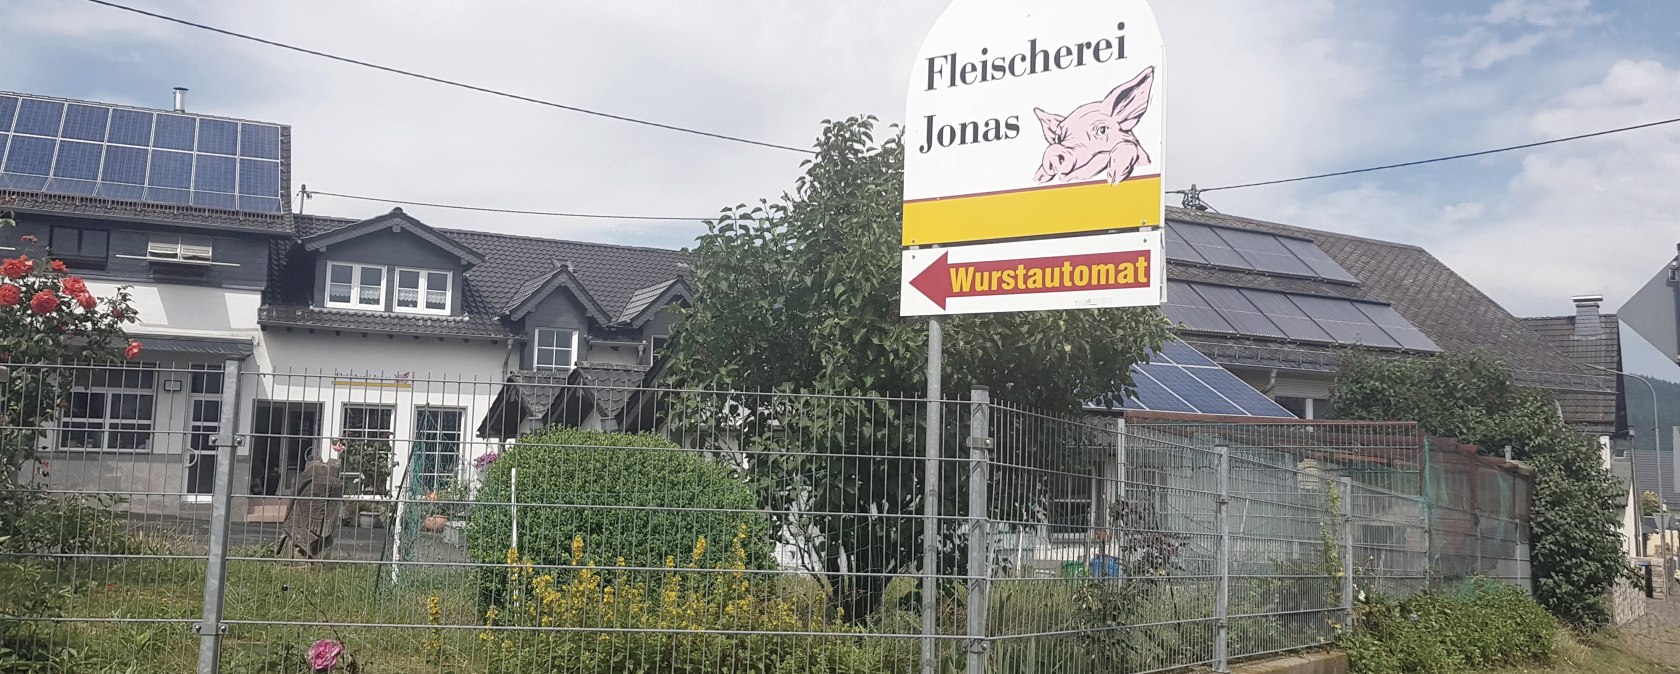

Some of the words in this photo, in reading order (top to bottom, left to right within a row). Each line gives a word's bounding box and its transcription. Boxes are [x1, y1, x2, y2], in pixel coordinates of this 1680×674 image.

[924, 21, 1127, 92] Fleischerei
[918, 114, 1020, 154] Jonas
[950, 256, 1148, 293] Wurstautomat
